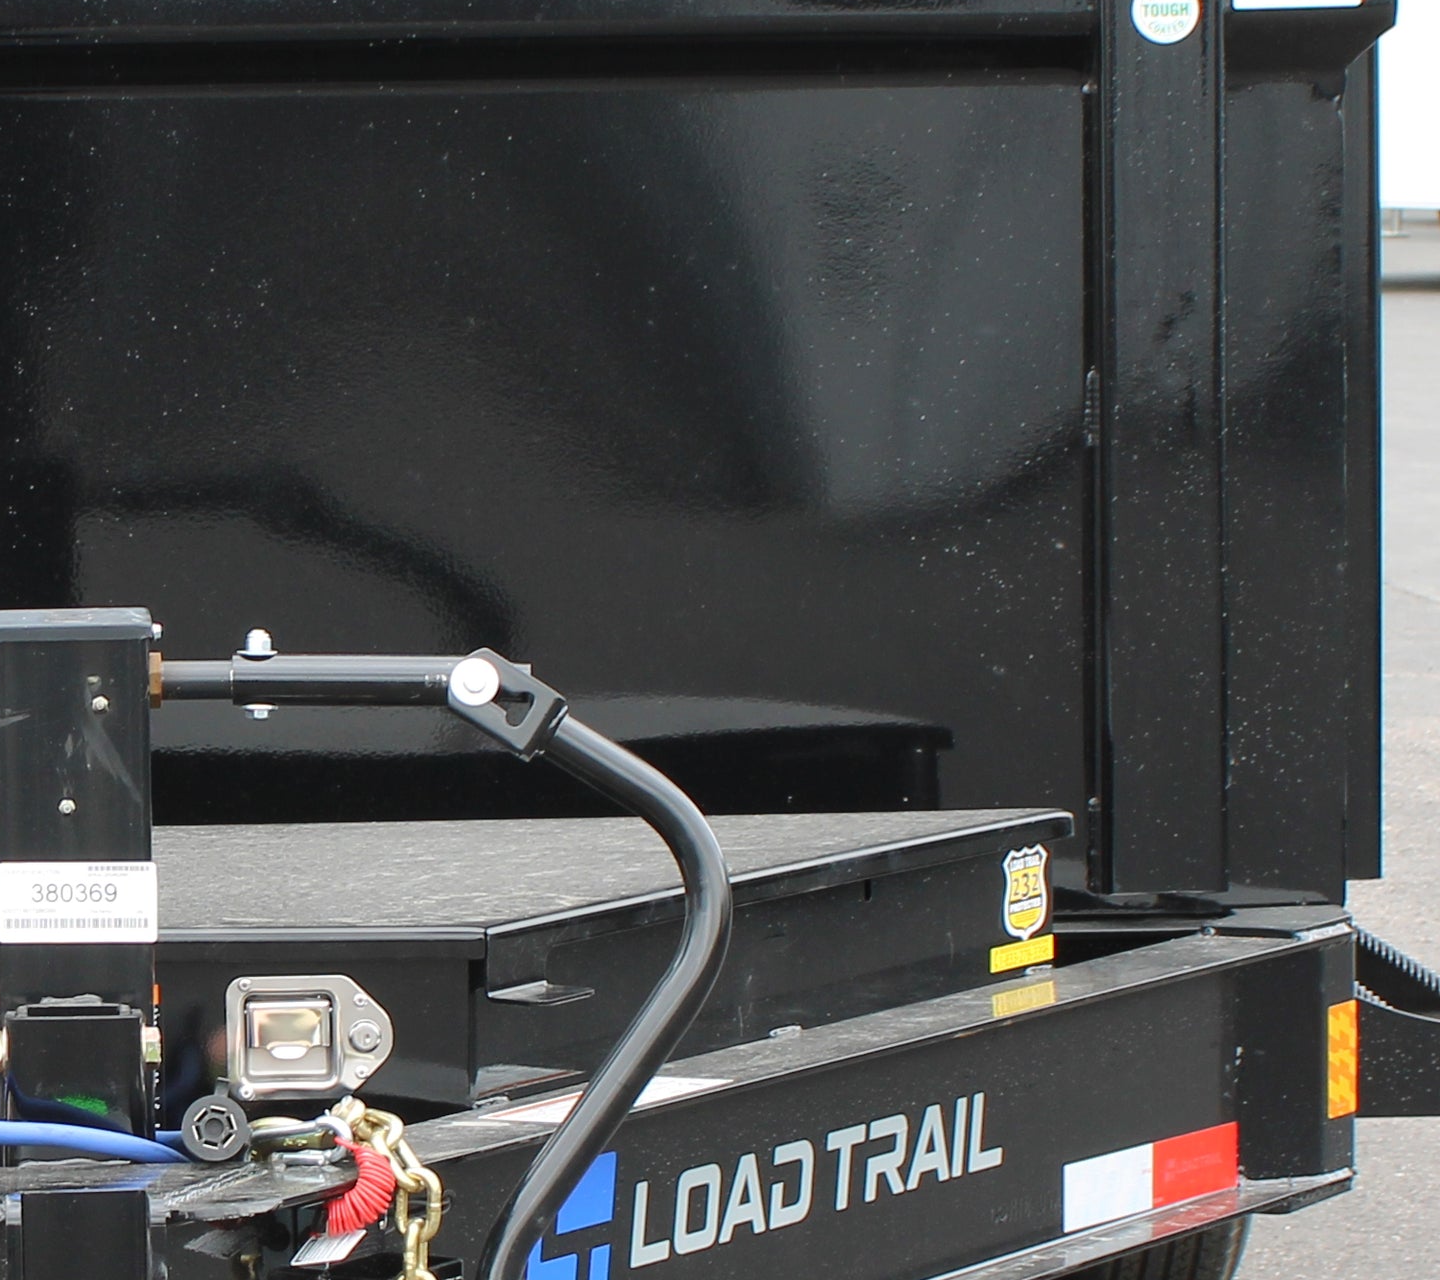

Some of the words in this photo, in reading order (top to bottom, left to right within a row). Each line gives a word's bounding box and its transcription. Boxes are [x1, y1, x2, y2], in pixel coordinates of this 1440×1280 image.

[1143, 2, 1189, 18] TOUGH
[31, 883, 118, 903] 380369
[1012, 872, 1040, 898] 232
[629, 1138, 814, 1269] LOAD
[824, 1091, 1004, 1213] TRAIL
